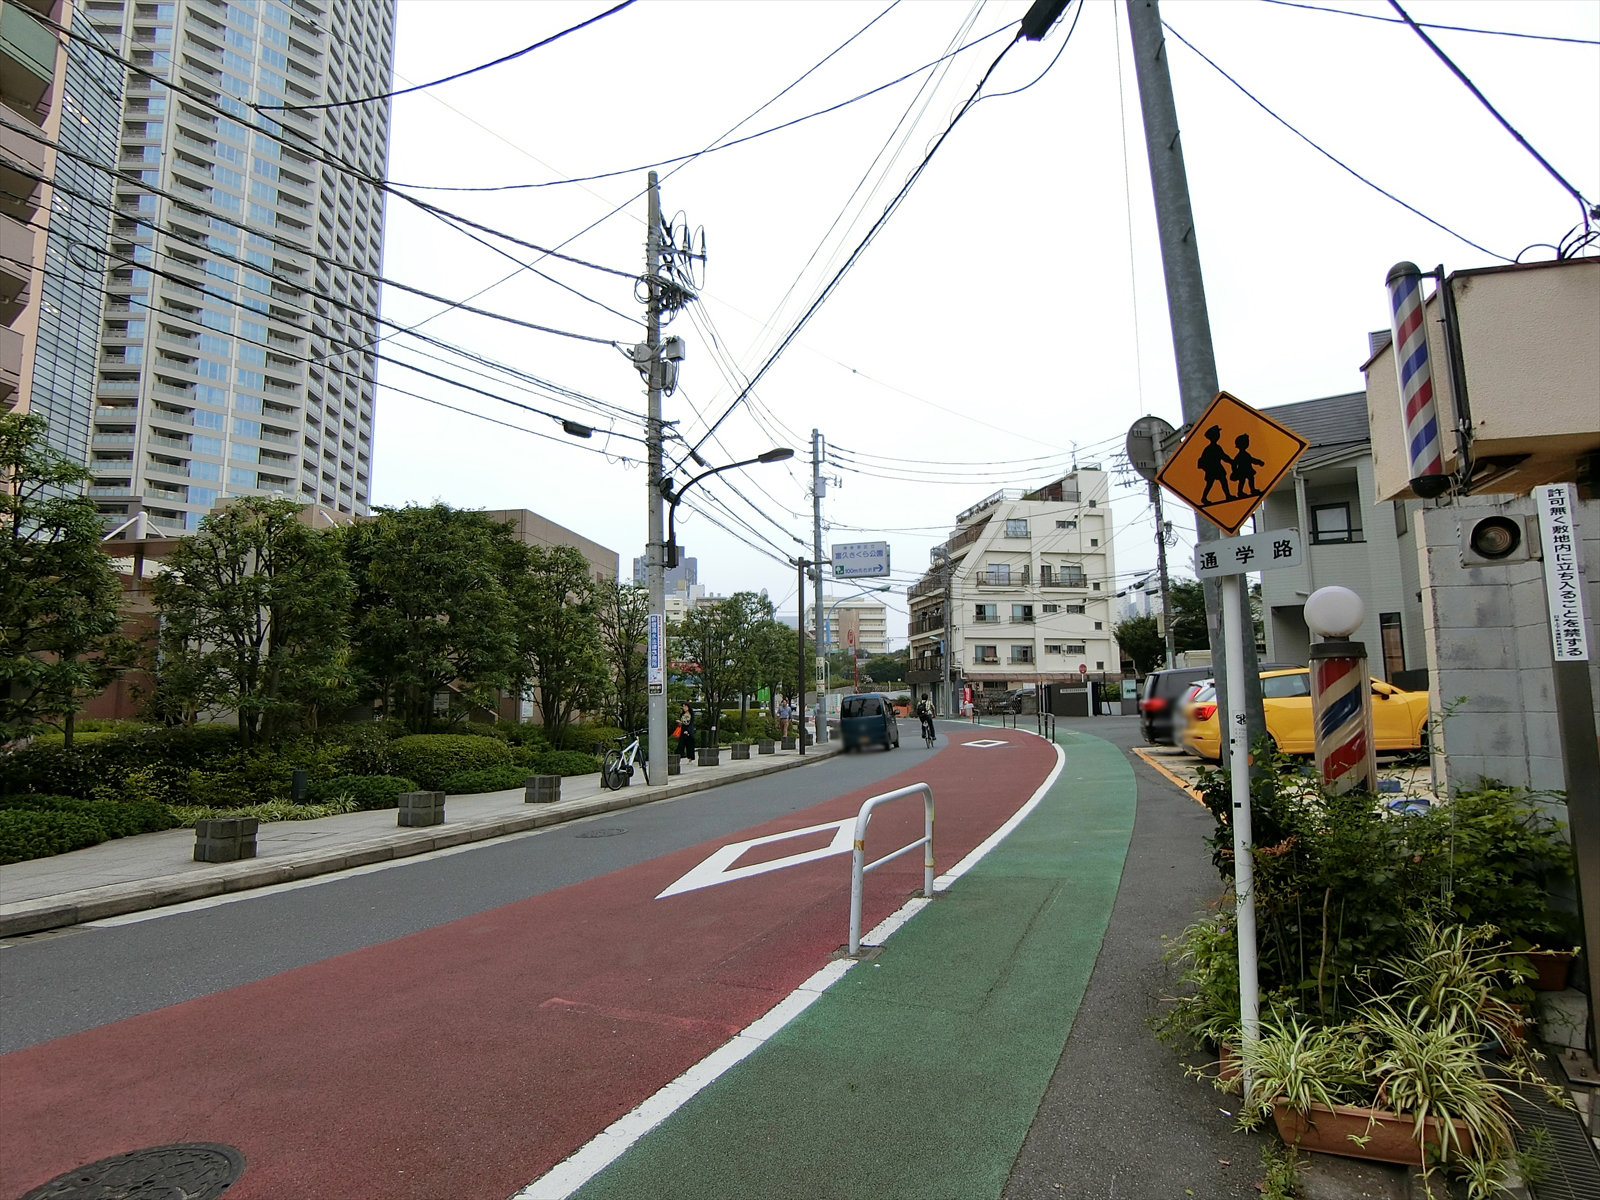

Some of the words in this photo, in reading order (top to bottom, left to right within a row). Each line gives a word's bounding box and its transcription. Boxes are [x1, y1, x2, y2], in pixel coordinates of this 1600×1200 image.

[835, 549, 883, 560] 富久さくら公園
[1200, 539, 1293, 571] 通学路
[1547, 488, 1583, 657] 許可無く敷地内に立ち入ることを禁ずる
